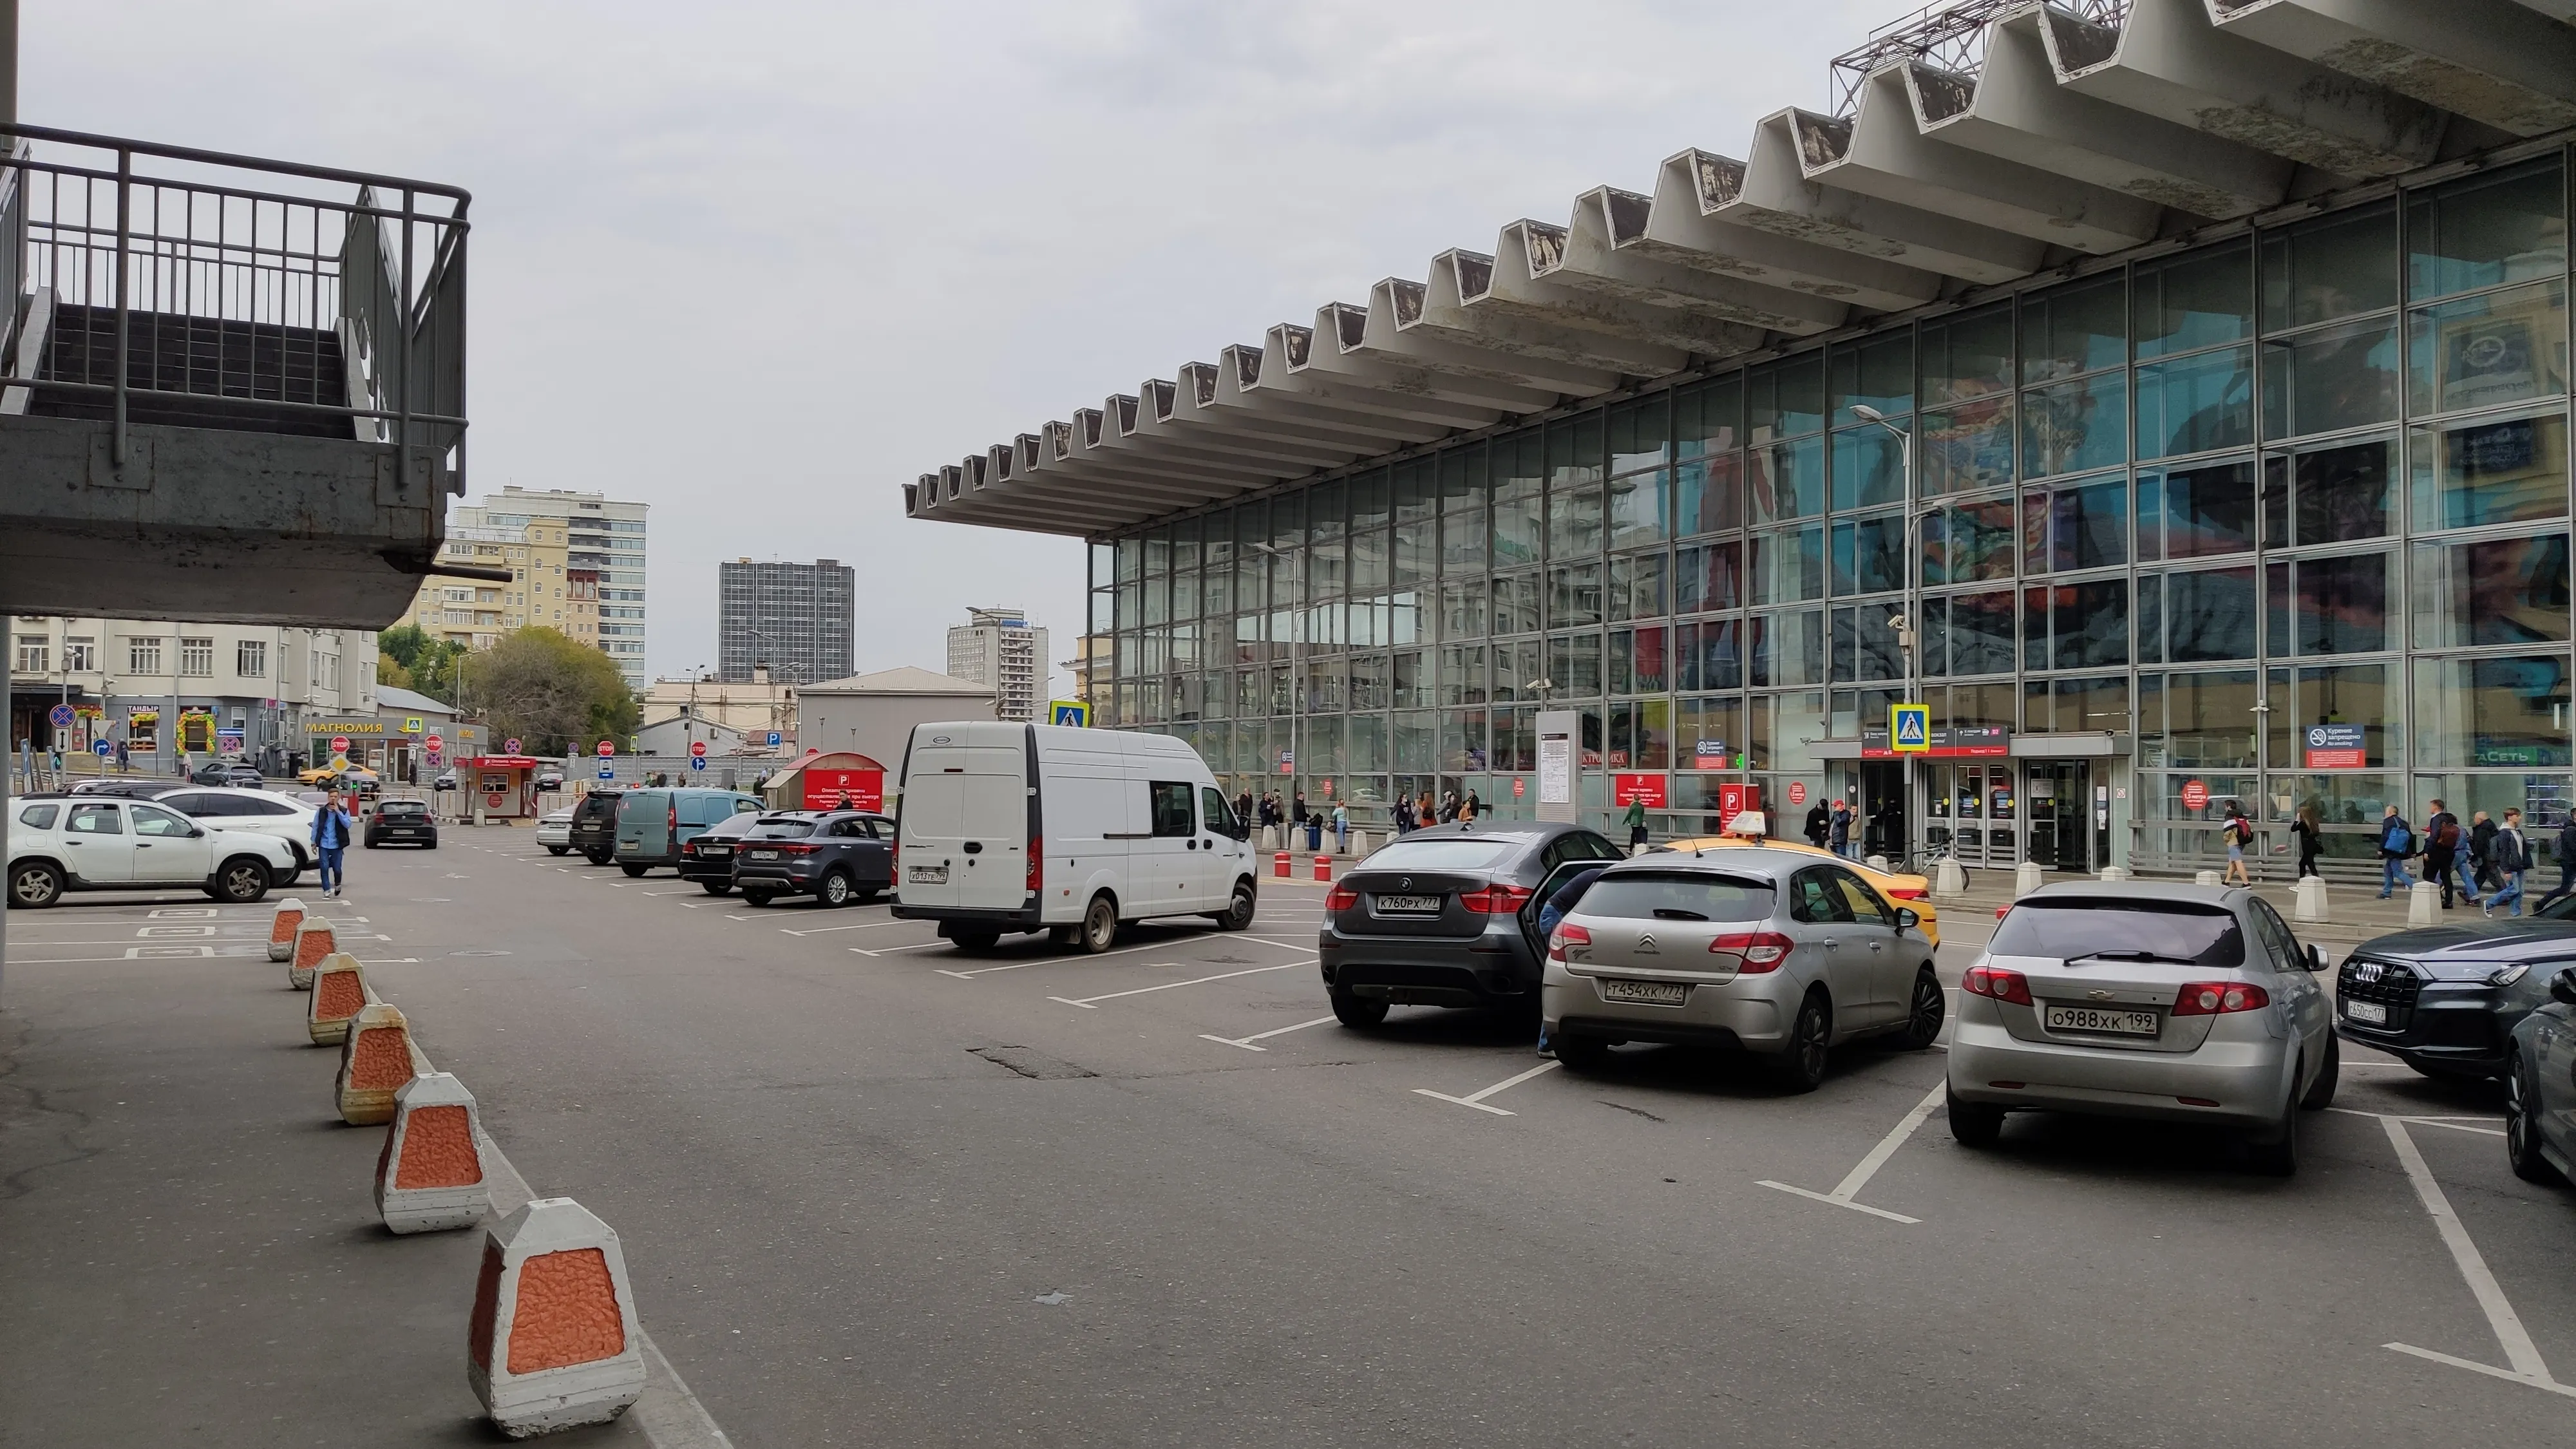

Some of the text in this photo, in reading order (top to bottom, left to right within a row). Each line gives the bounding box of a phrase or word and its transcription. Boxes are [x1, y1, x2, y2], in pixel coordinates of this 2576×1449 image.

[305, 723, 383, 732] МАГНОЛИЯ
[770, 734, 777, 744] P
[1583, 753, 1624, 763] КТРОИКА
[1728, 795, 1736, 808] P
[911, 872, 934, 880] Х013ТЕ
[1381, 897, 1437, 908] К760РХ 777
[1611, 983, 1680, 998] Т454ХК 777
[2350, 1003, 2384, 1019] С650СС 177
[2053, 1010, 2152, 1030] О988ХК 199
